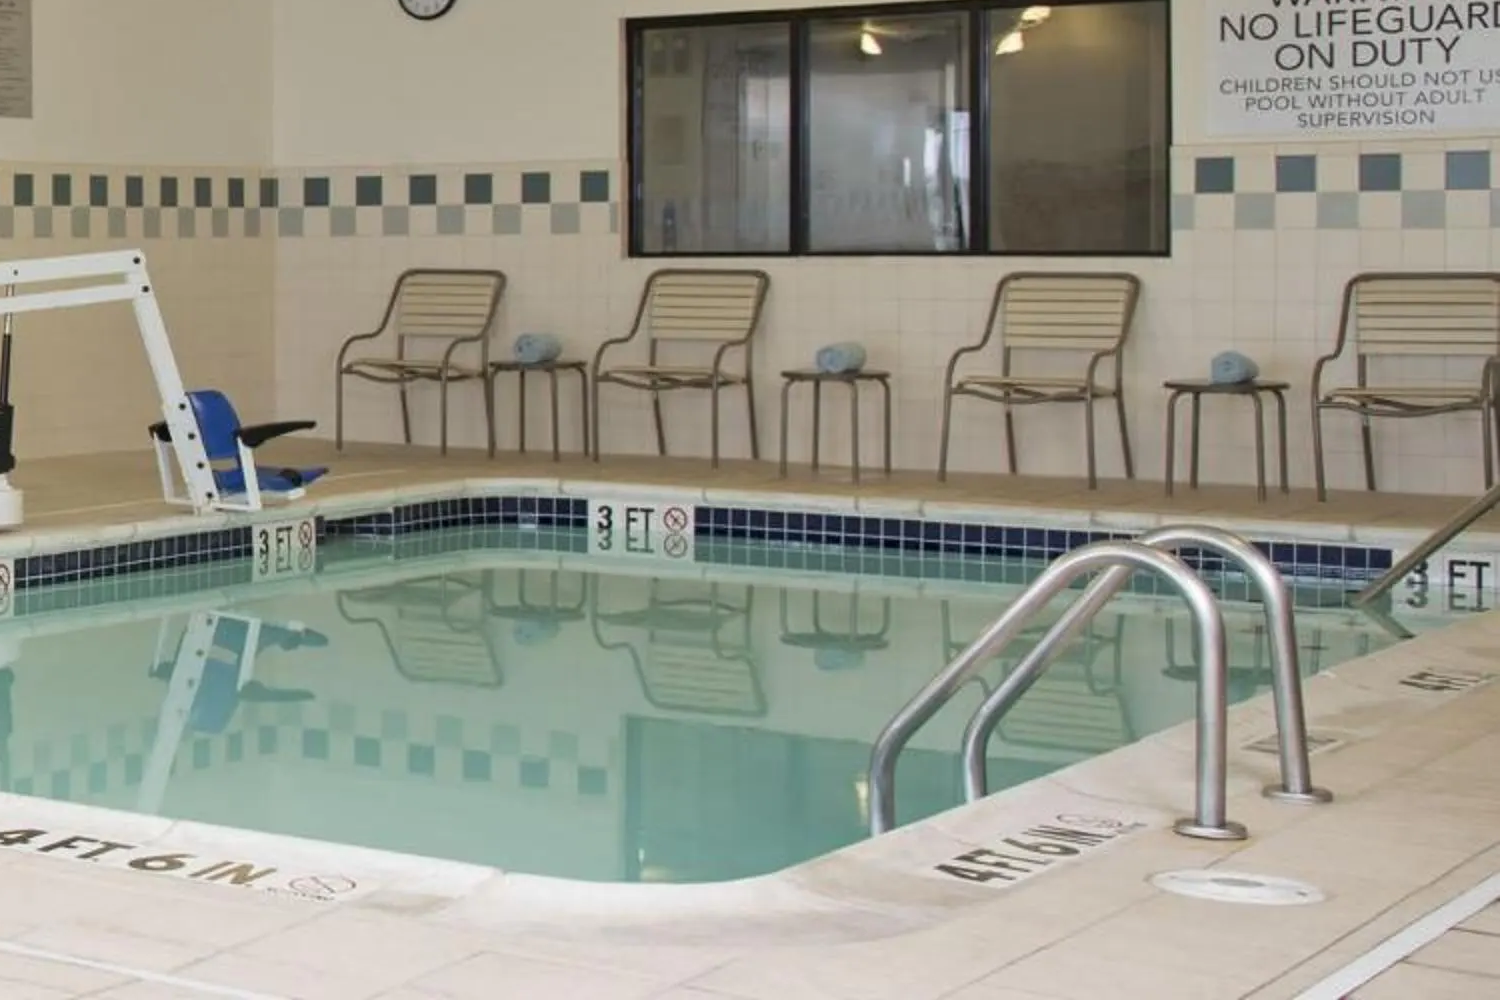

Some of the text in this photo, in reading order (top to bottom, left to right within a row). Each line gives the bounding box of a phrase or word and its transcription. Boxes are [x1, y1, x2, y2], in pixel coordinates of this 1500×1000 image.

[1220, 12, 1278, 42] NO
[1275, 35, 1460, 71] ON DUTY
[1219, 75, 1321, 95] CHILDREN
[1329, 71, 1416, 91] SHOULD
[1423, 69, 1472, 87] NOT
[1245, 88, 1487, 112] POOL WITHOUT ADULT
[1297, 109, 1435, 128] SUPERVISION
[598, 505, 654, 532] 3 FT
[259, 525, 293, 554] 3 FT
[1449, 560, 1490, 588] FT
[1002, 838, 1081, 856] 6
[1021, 824, 1116, 846] IN
[37, 835, 137, 859] FT
[128, 853, 198, 871] 6
[189, 860, 278, 886] IN
[934, 864, 1016, 882] 4
[953, 848, 1054, 872] FT
